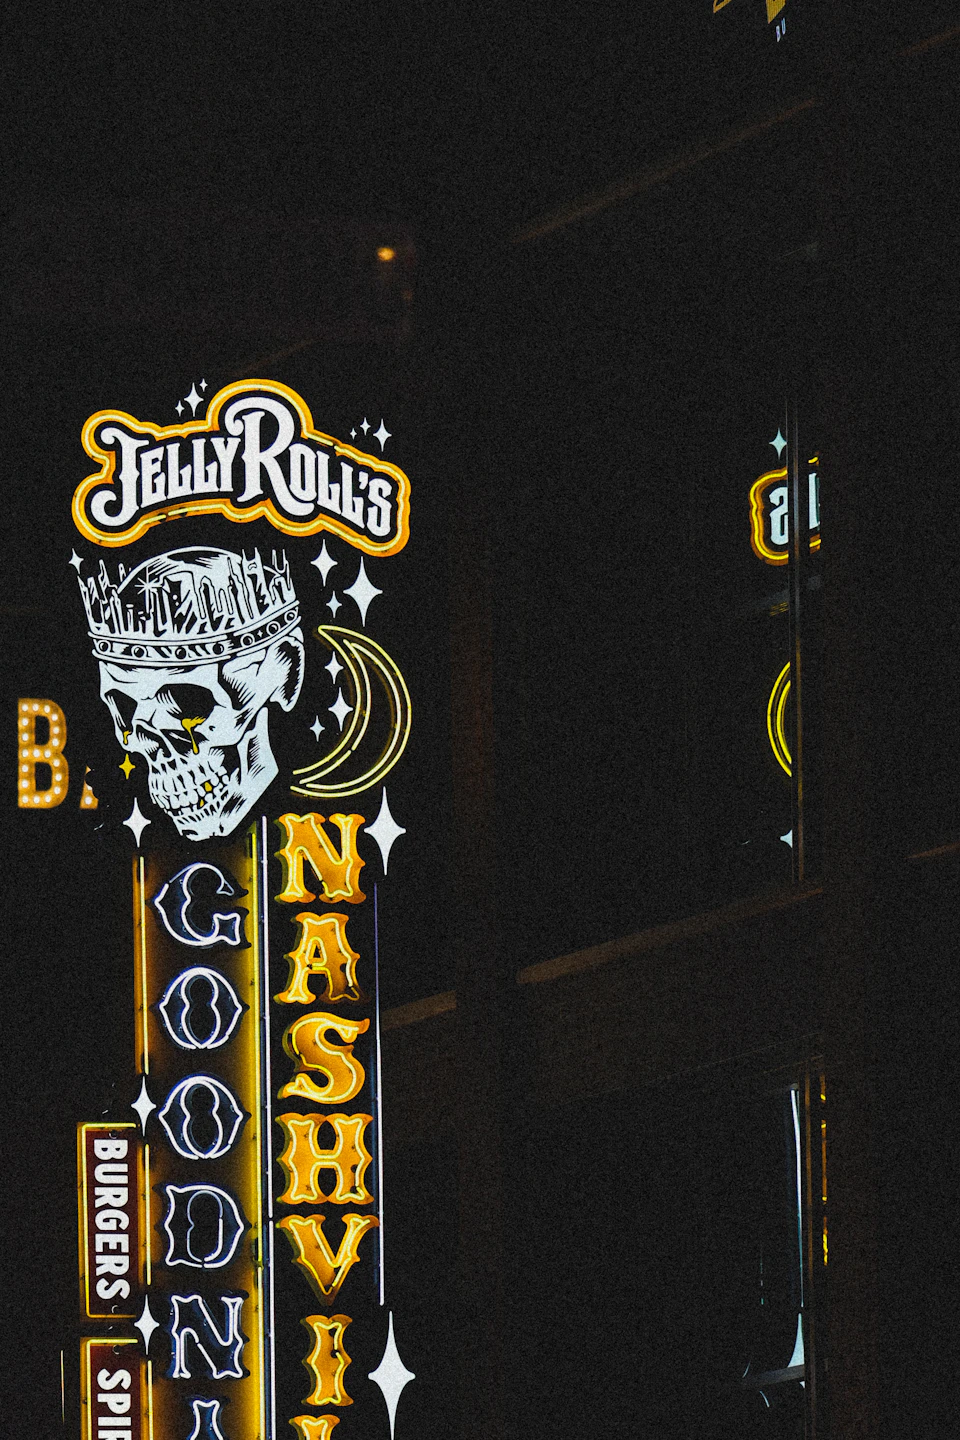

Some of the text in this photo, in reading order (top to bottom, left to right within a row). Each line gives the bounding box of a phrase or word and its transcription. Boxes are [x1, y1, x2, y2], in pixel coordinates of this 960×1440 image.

[91, 396, 393, 537] JELLY ROLL'S
[18, 697, 99, 810] B
[93, 1137, 131, 1304] BURGERS
